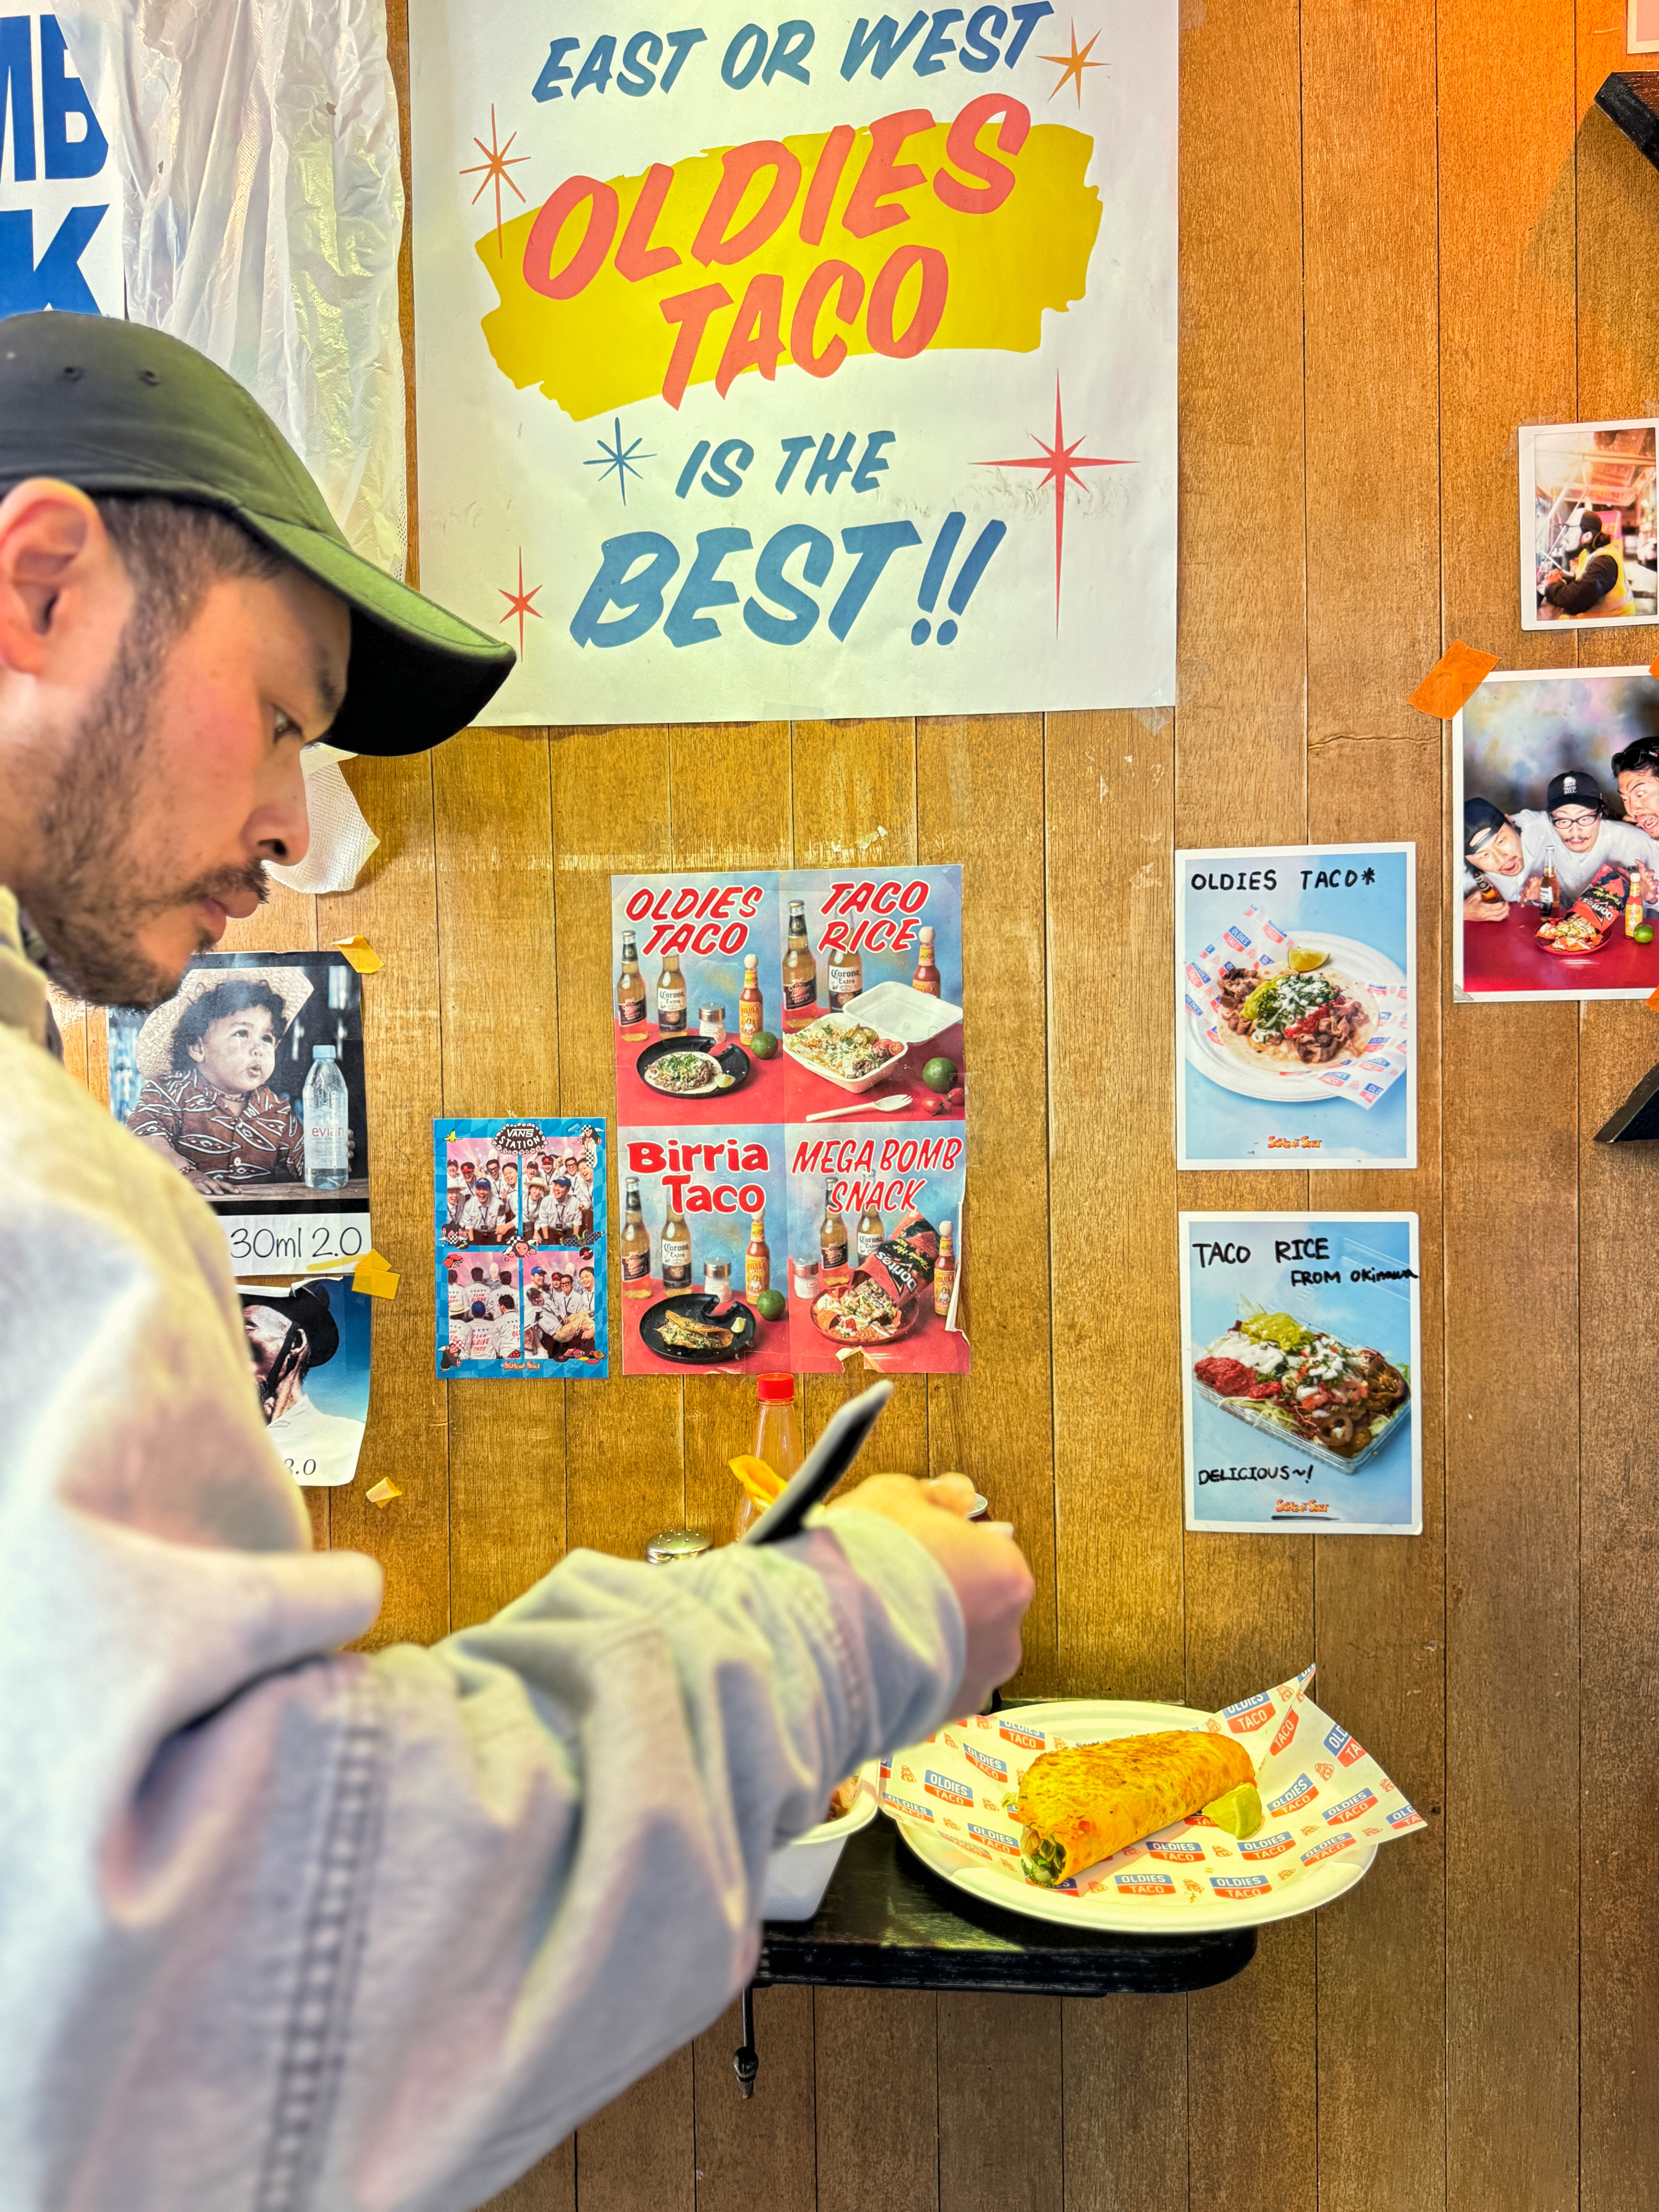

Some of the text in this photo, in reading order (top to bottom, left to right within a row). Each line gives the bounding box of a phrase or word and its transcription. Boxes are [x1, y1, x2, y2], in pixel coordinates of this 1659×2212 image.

[531, 0, 1055, 103] EAST OR WEST
[523, 93, 1032, 301] OLDIES
[659, 244, 949, 411] TACO
[676, 430, 896, 500] IS THE
[569, 511, 1008, 650] BEST!!
[1191, 869, 1278, 891] OLDIES
[625, 885, 764, 922] OLDIES
[819, 879, 930, 916] TACO
[1582, 898, 1613, 921] Doritos
[641, 922, 749, 956] TACO
[817, 917, 922, 954] RICE
[1231, 927, 1249, 946] OLDIES
[831, 969, 860, 978] Corona
[660, 991, 685, 999] Corona
[312, 1126, 344, 1137] evian
[498, 1135, 540, 1149] STATION
[507, 1128, 534, 1137] VANS
[625, 1138, 771, 1174] Birria
[791, 1137, 963, 1174] MEGA BOMB
[661, 1173, 766, 1215] Taco
[827, 1178, 928, 1214] SNACK
[312, 1227, 362, 1257] 2.0
[1192, 1238, 1329, 1267] TACO RICE
[876, 1251, 918, 1293] Doritos
[1291, 1270, 1341, 1286] FROM
[1237, 1711, 1267, 1731] TACO
[1008, 1732, 1036, 1748] TACO
[1274, 1719, 1294, 1748] TACO
[968, 1747, 1001, 1769] OLDIES
[975, 1758, 998, 1780] TACO
[930, 1774, 967, 1796] OLDIES
[1272, 1779, 1307, 1808] OLDIES
[887, 1795, 927, 1814] OLDIES
[935, 1789, 964, 1805] TACO
[1281, 1795, 1310, 1814] TACO
[1328, 1792, 1367, 1816] OLDIES
[895, 1804, 924, 1819] TACO
[1337, 1803, 1368, 1822] TACO
[973, 1826, 1013, 1845] OLDIES
[981, 1837, 1010, 1853] TACO
[1243, 1834, 1286, 1851] OLDIES
[1305, 1834, 1346, 1858] OLDIES
[1152, 1843, 1195, 1851] OLDIES
[1161, 1852, 1195, 1861] TACO
[1253, 1845, 1286, 1859] TACO
[1313, 1843, 1345, 1861] TACO
[1129, 1885, 1164, 1893] TACO
[1216, 1877, 1261, 1887] OLDIES
[1226, 1889, 1261, 1898] TACO
